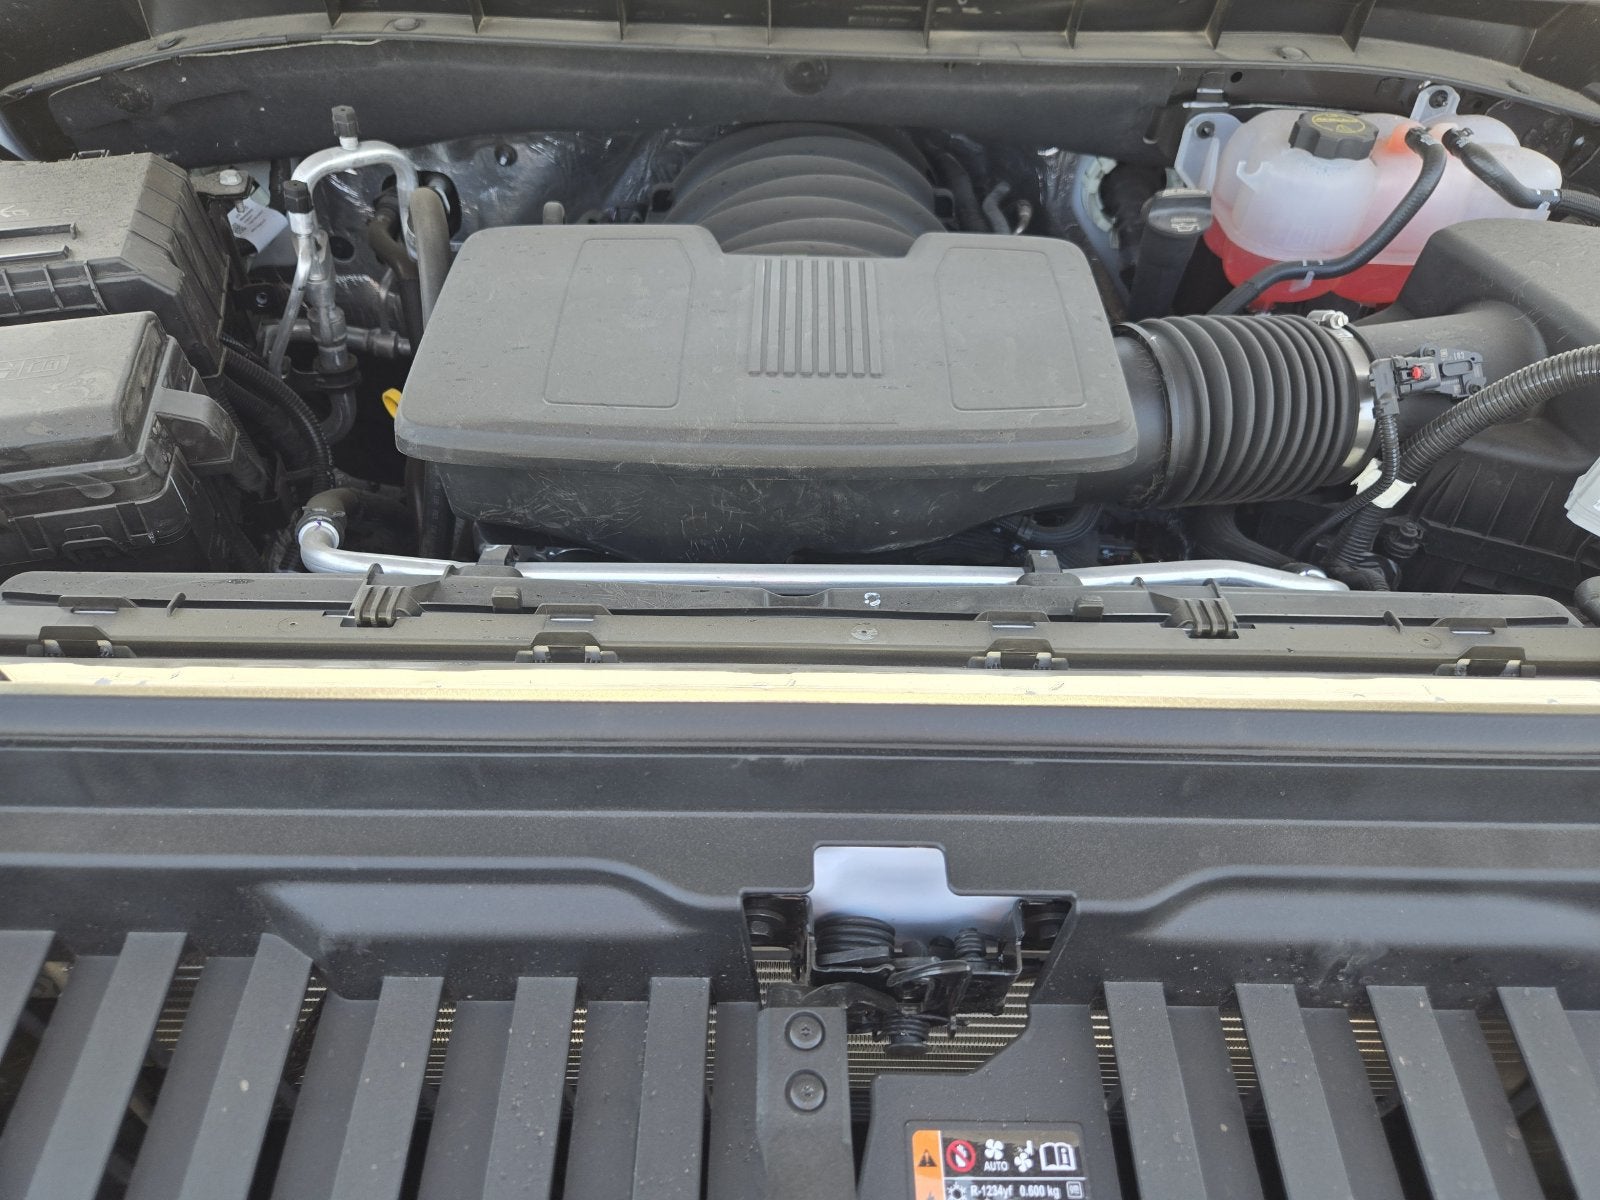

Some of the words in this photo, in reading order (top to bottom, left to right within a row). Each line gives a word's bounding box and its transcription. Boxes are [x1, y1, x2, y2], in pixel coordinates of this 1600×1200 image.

[984, 1161, 1009, 1172] AUTO
[970, 1184, 1013, 1198] R-1234yf
[1019, 1184, 1045, 1196] 0.600
[1048, 1184, 1060, 1198] kg
